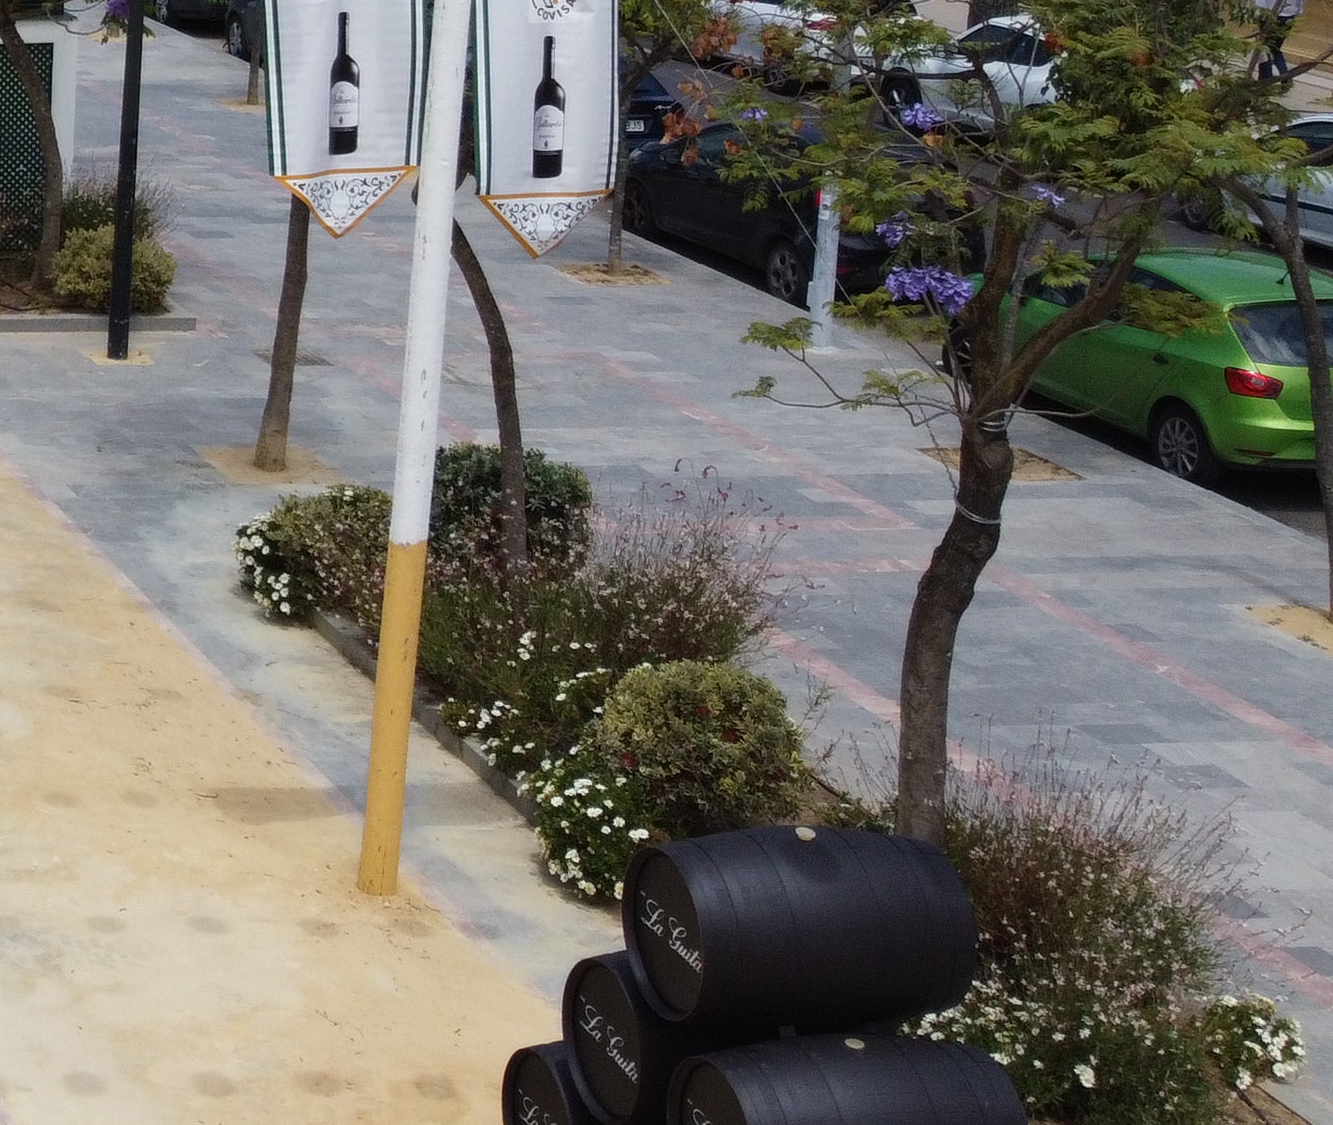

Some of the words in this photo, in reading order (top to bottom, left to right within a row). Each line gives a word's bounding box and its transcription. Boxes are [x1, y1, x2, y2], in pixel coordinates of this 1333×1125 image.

[640, 898, 665, 937] La
[668, 916, 703, 974] Guita
[579, 1004, 603, 1043] La
[606, 1026, 639, 1084] Guita
